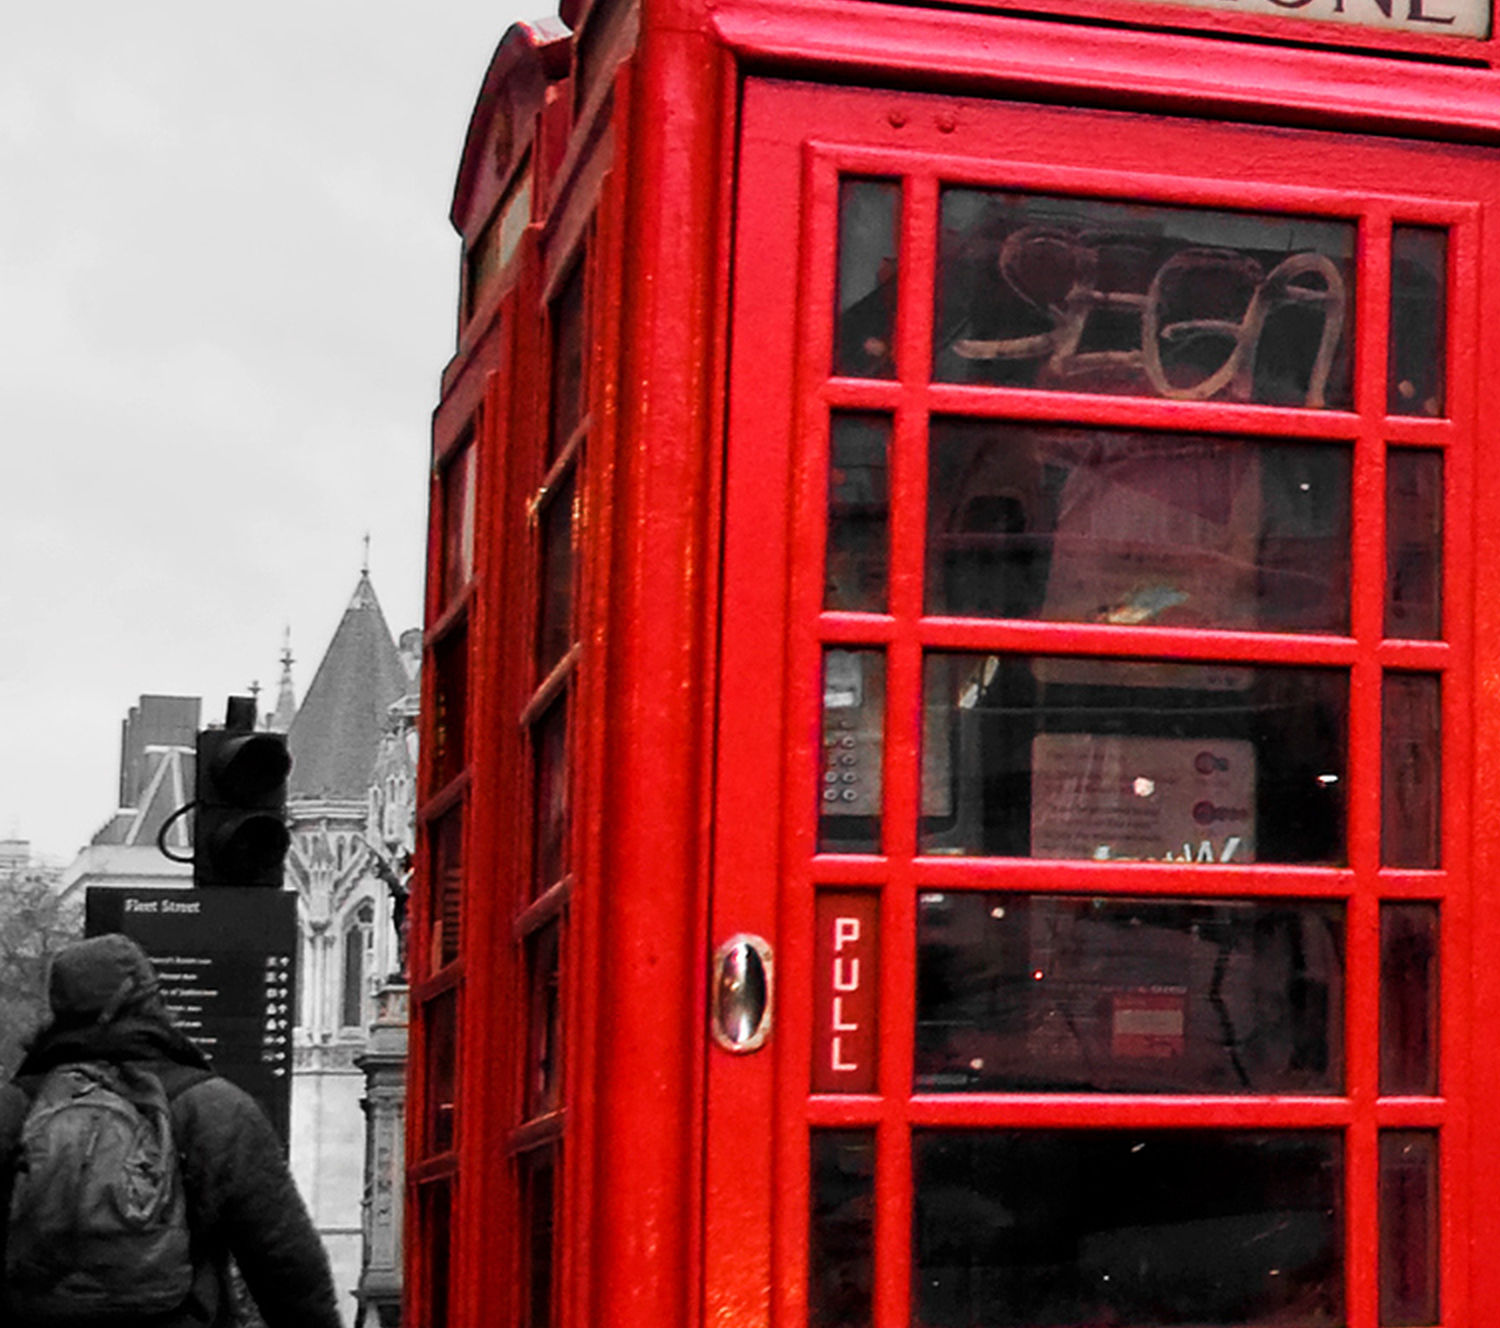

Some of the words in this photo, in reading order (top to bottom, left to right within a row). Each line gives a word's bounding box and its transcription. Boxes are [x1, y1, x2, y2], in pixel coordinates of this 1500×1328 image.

[125, 898, 158, 912] Fleet
[161, 898, 201, 912] Street
[832, 917, 860, 1070] PULL
